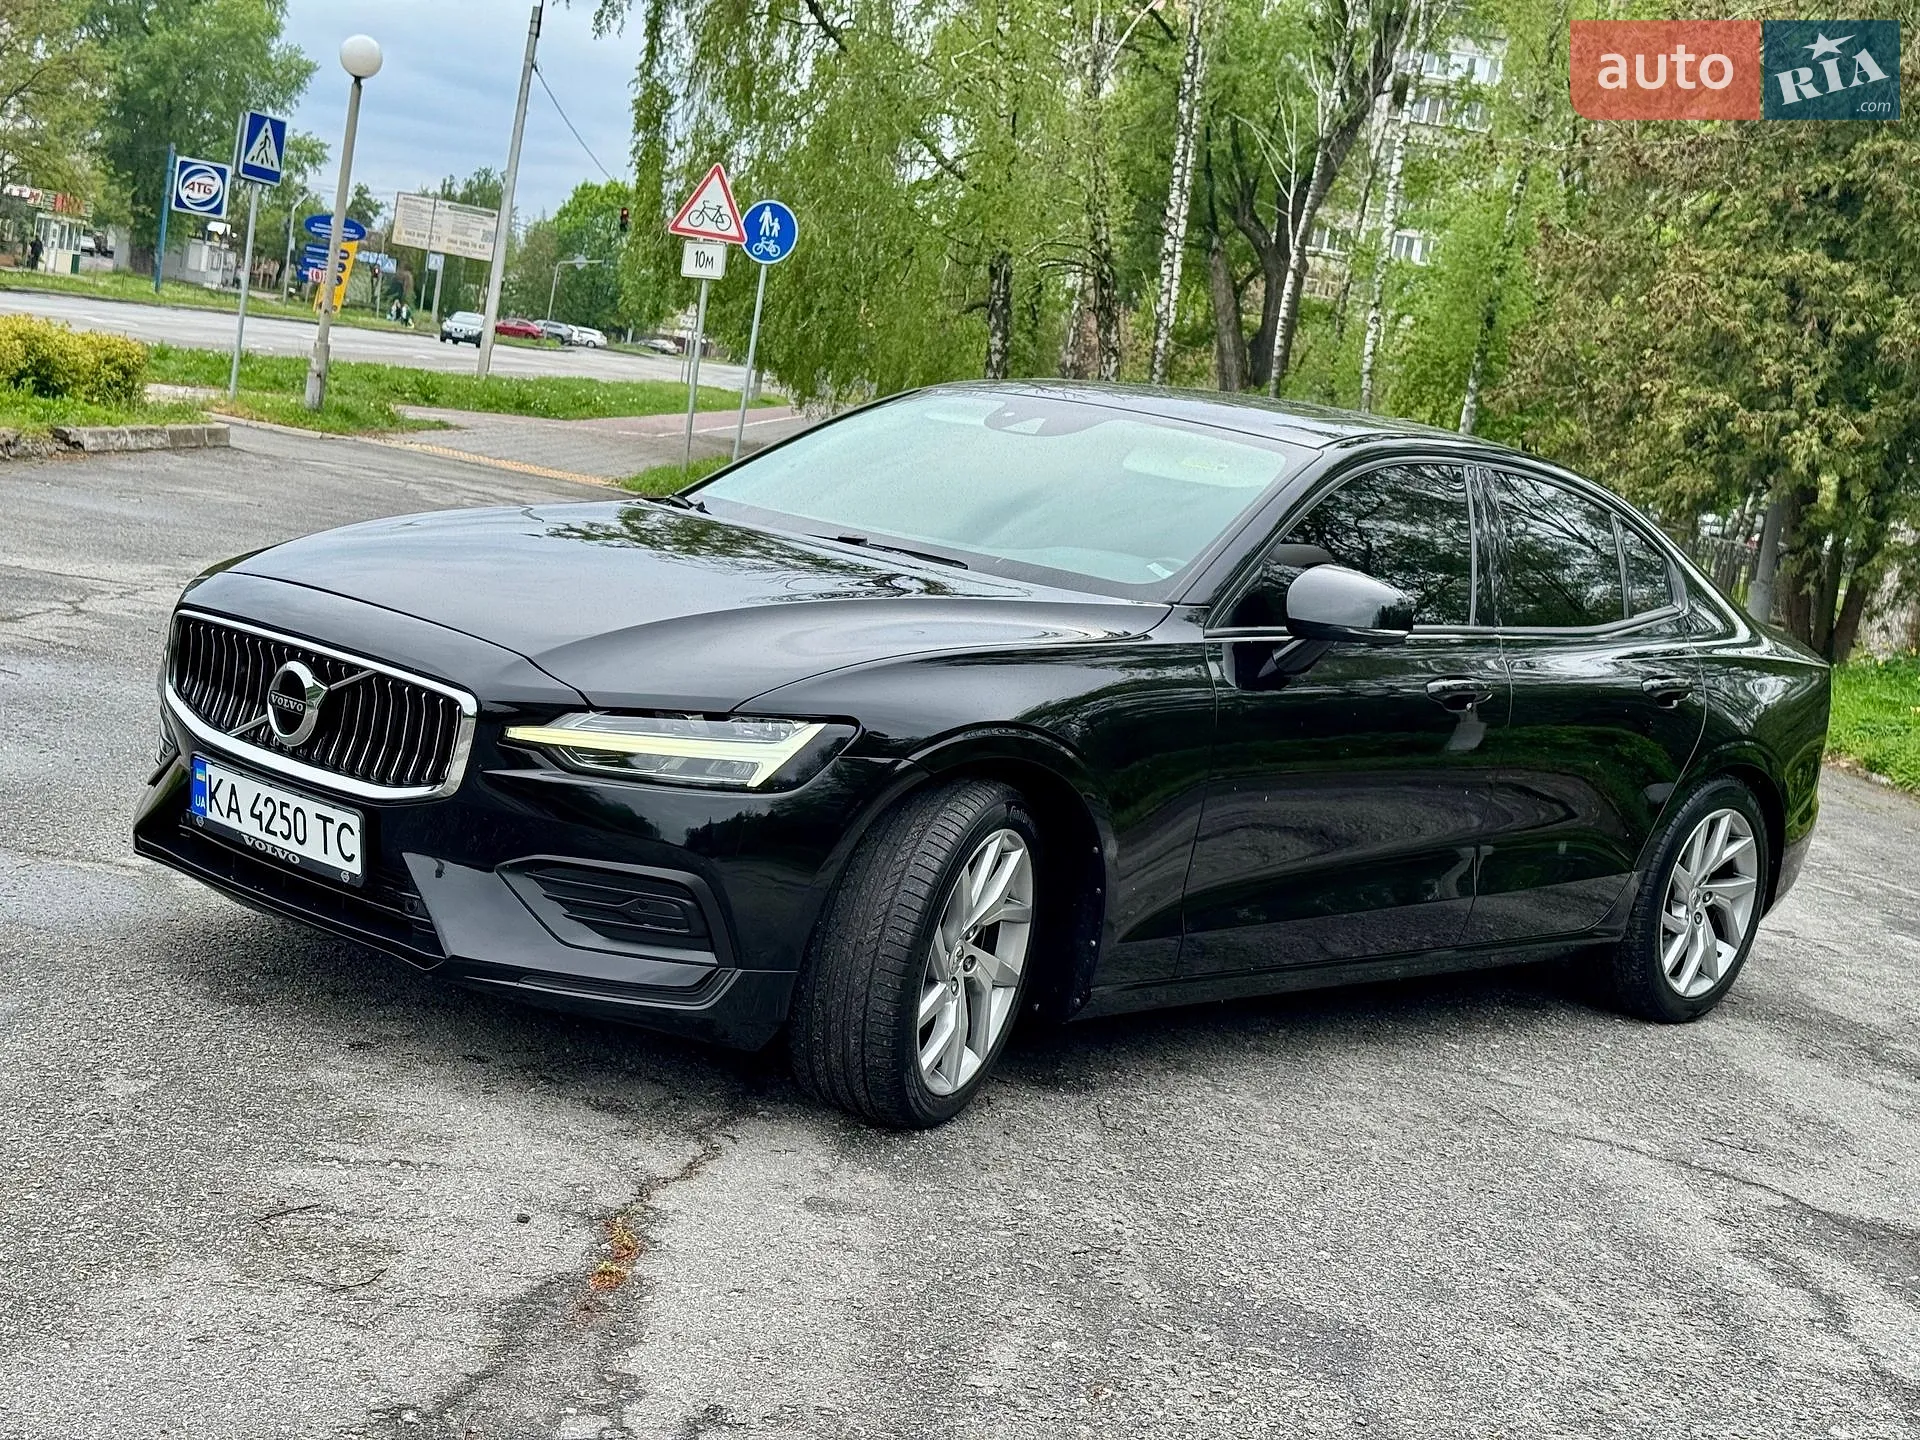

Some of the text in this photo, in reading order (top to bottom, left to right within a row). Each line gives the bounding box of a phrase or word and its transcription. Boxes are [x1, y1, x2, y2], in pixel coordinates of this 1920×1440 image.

[185, 181, 214, 195] ATG
[270, 693, 304, 712] VOLVO
[195, 794, 206, 809] UA
[208, 774, 356, 863] KA 4250 TC
[241, 833, 300, 865] VOLVO
